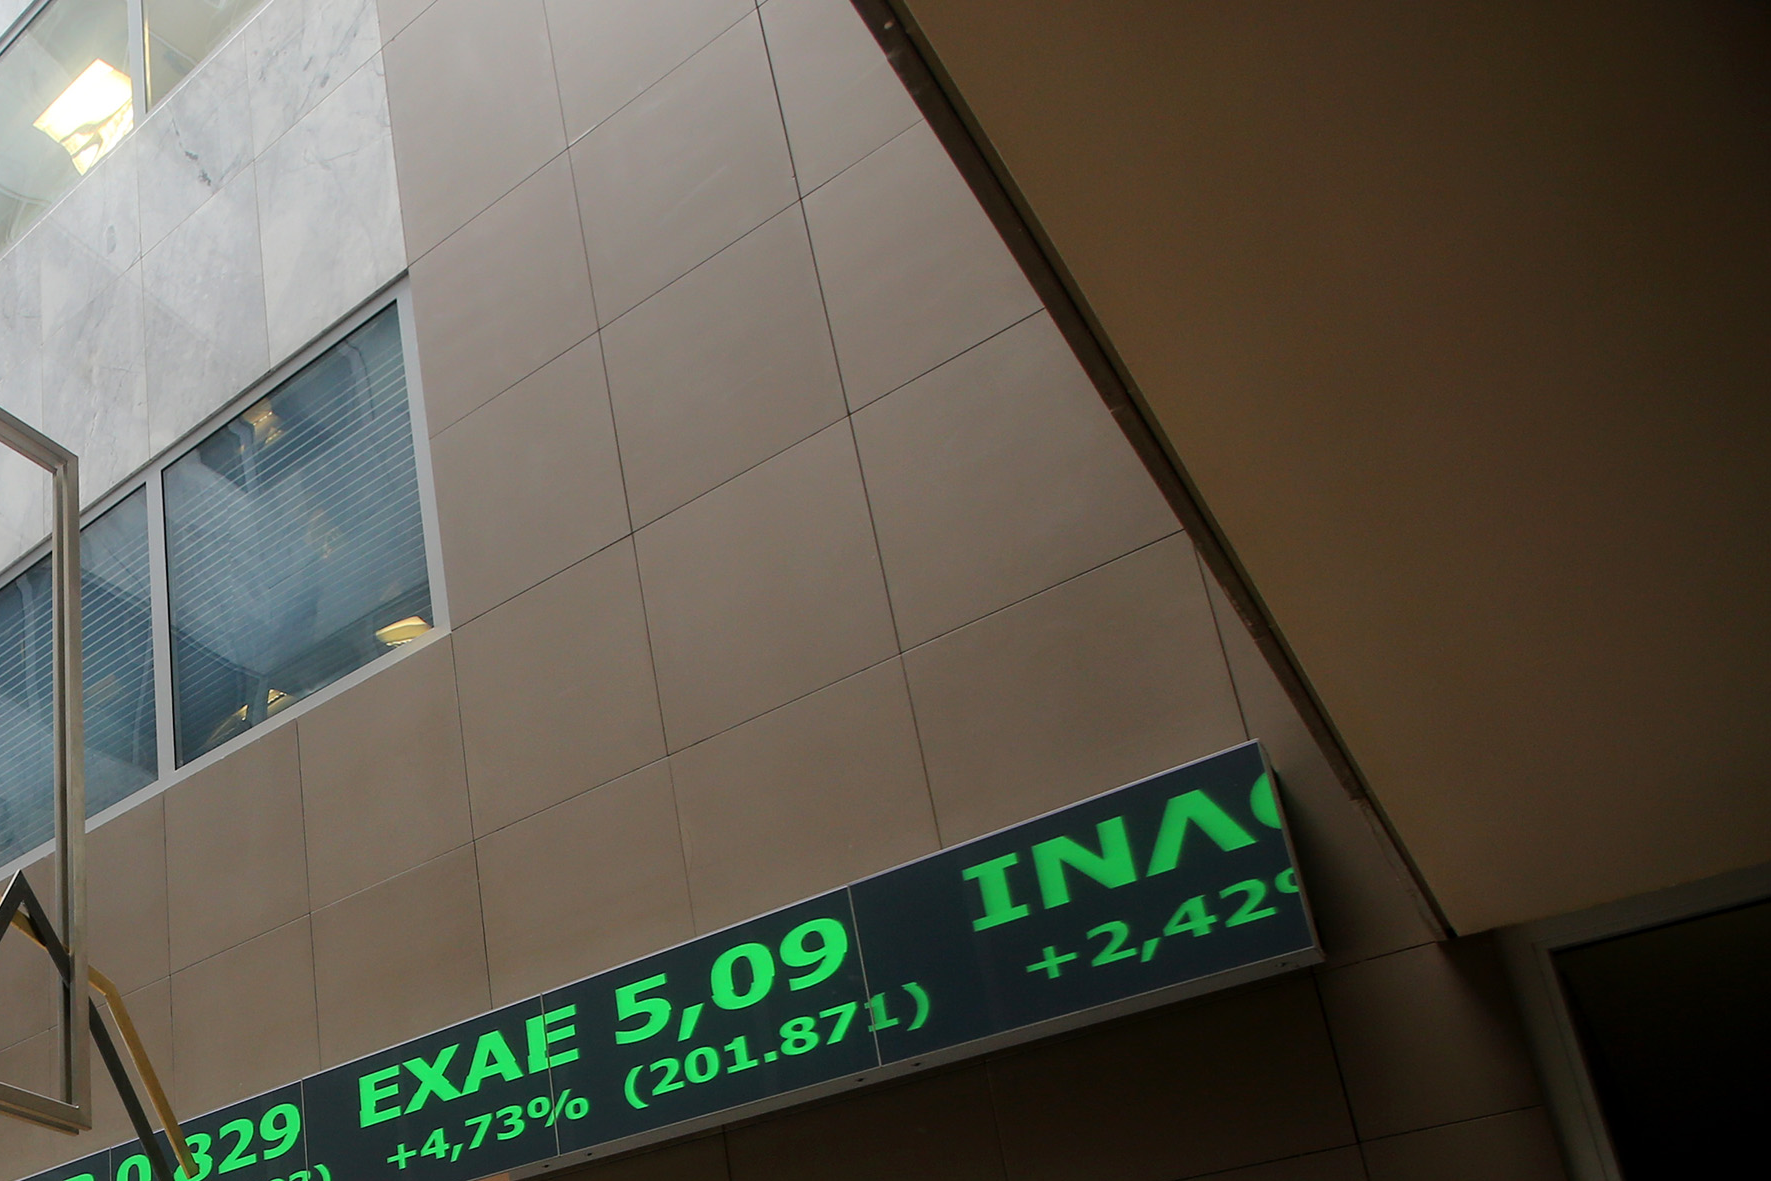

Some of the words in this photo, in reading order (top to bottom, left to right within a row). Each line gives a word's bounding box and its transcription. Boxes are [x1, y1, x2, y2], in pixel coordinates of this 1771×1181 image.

[358, 1005, 582, 1128] ΕΧΑΕ
[615, 917, 849, 1045] 5,09
[386, 1089, 590, 1170] +4,73%
[623, 981, 931, 1109] (201.871)
